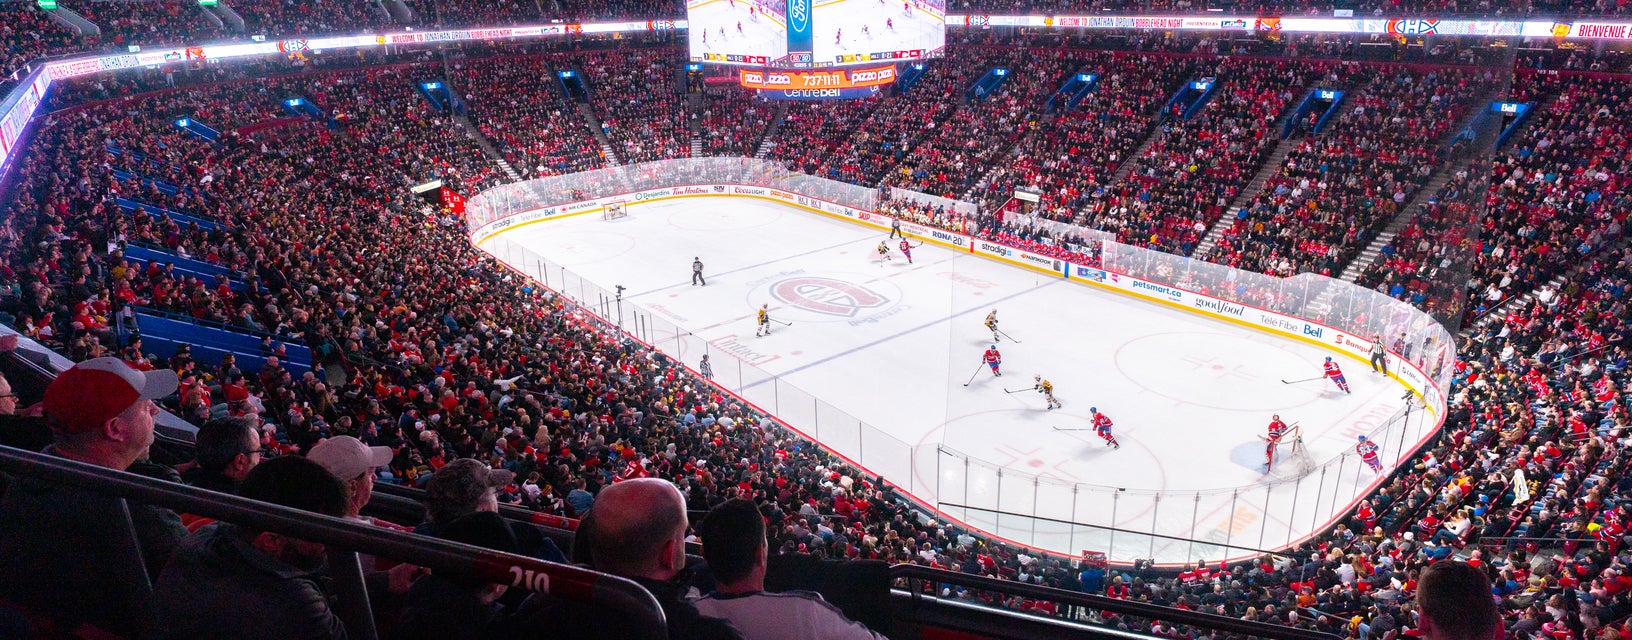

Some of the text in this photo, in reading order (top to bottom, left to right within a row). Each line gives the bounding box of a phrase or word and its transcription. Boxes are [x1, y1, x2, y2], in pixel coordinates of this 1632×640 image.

[792, 0, 808, 21] For
[1059, 18, 1080, 27] WELCOME
[1081, 18, 1087, 27] TO
[1168, 19, 1184, 28] NIGHT
[1579, 25, 1626, 38] BIENVENUE
[852, 71, 877, 85] pizza
[1321, 90, 1334, 99] Bell
[1501, 103, 1517, 113] Bell
[544, 208, 556, 217] Bell
[844, 208, 853, 216] Bell
[932, 231, 952, 241] RONA
[953, 236, 962, 246] 20
[1132, 280, 1182, 298] petsmart.ca
[1195, 298, 1245, 316] goodfood
[1279, 319, 1298, 332] Fibe
[1303, 323, 1323, 338] Bell
